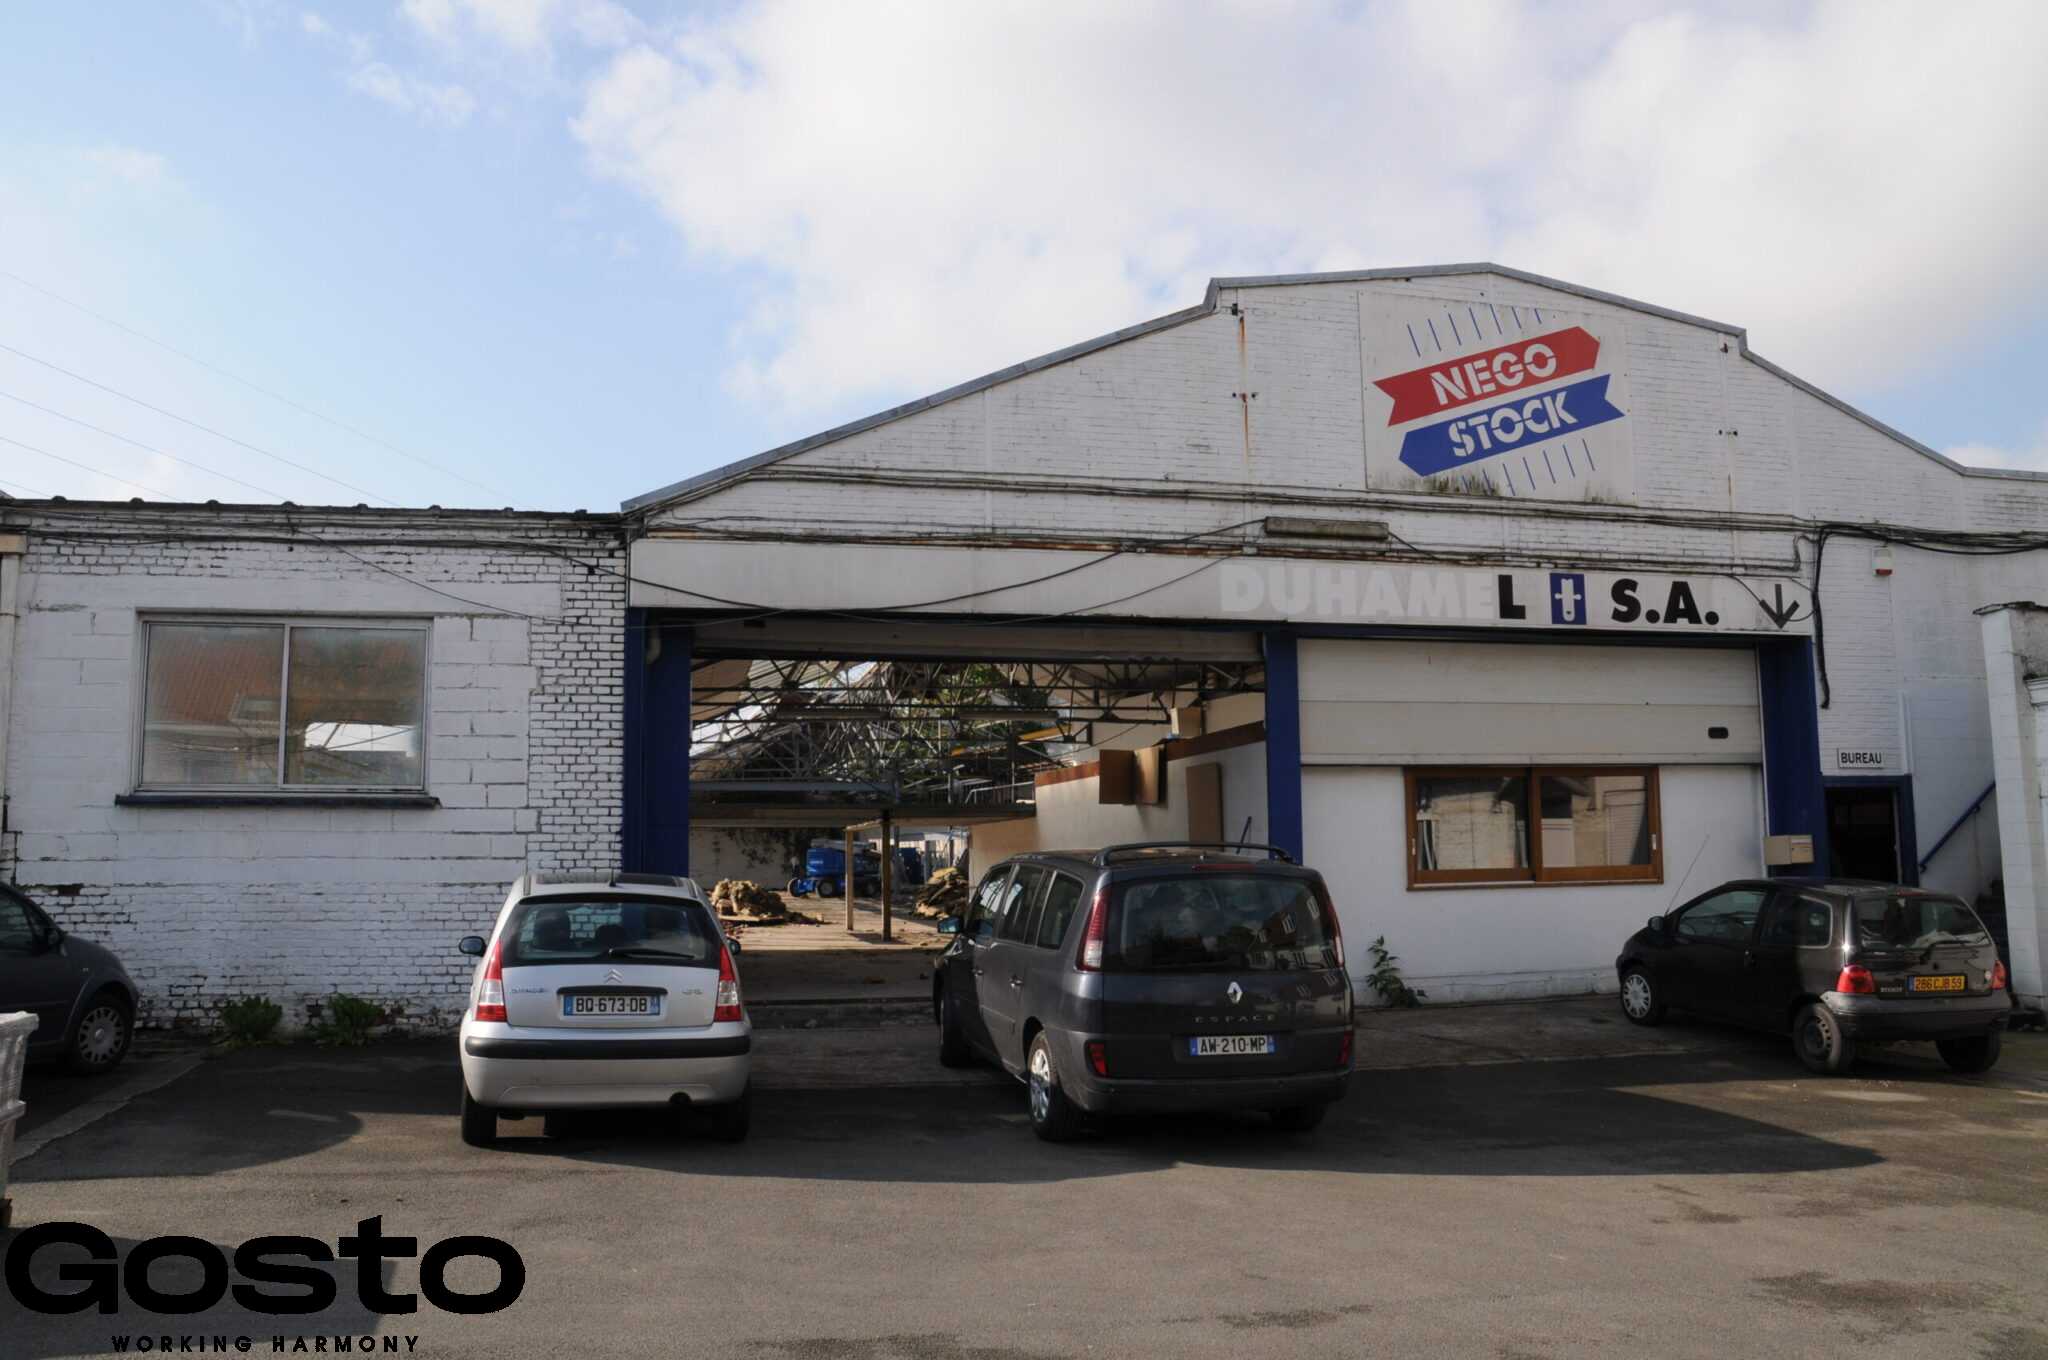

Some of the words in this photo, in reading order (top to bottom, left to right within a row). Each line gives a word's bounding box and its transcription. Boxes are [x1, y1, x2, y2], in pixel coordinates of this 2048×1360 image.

[1430, 343, 1557, 406] NEGO
[1448, 391, 1579, 457] STOCK
[1610, 577, 1720, 625] S.A.
[1840, 752, 1882, 764] BUREAU
